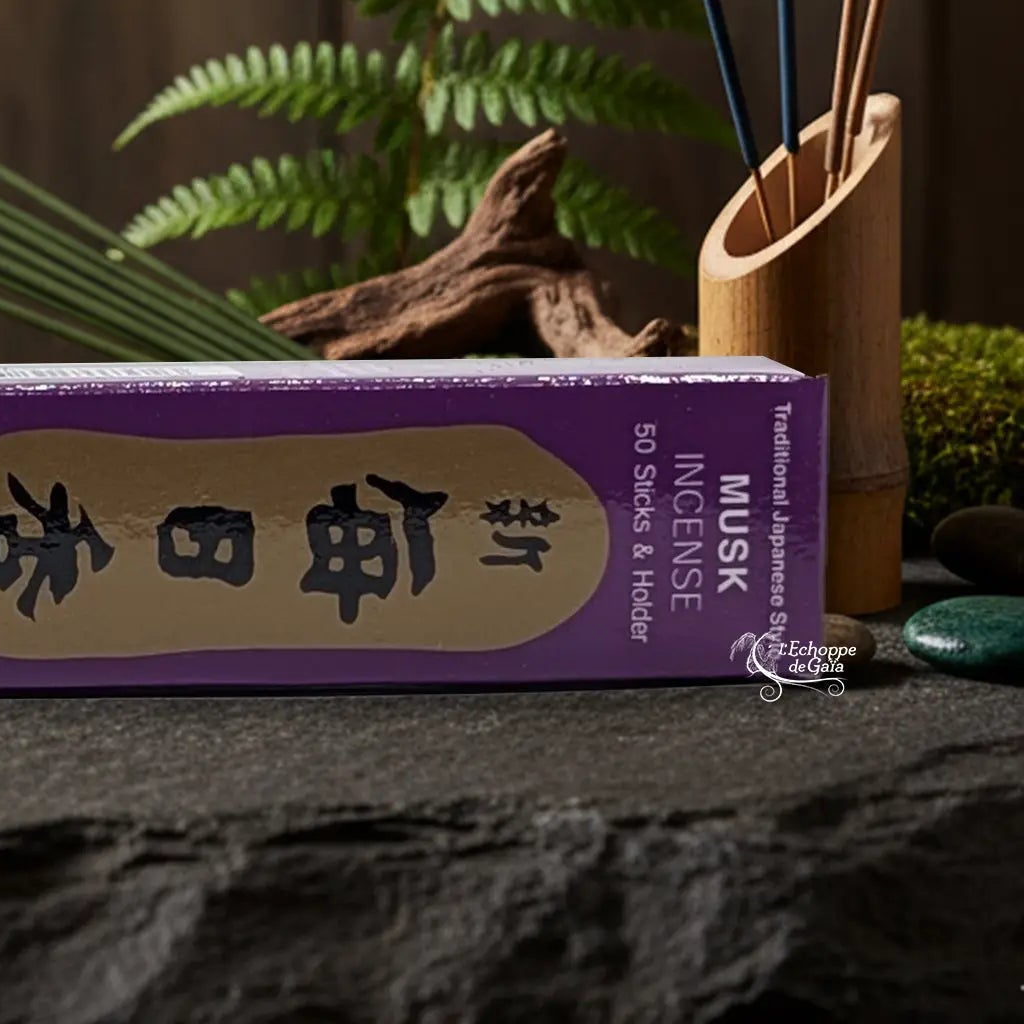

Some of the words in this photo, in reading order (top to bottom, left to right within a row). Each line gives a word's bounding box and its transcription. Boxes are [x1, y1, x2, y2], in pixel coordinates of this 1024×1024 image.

[633, 422, 656, 455] 50
[771, 401, 793, 507] Traditional
[633, 464, 657, 533] Sticks
[670, 453, 705, 612] INCENSE
[716, 474, 750, 594] MUSK
[632, 543, 654, 560] &
[768, 510, 790, 607] Japanese
[630, 570, 655, 643] Holder
